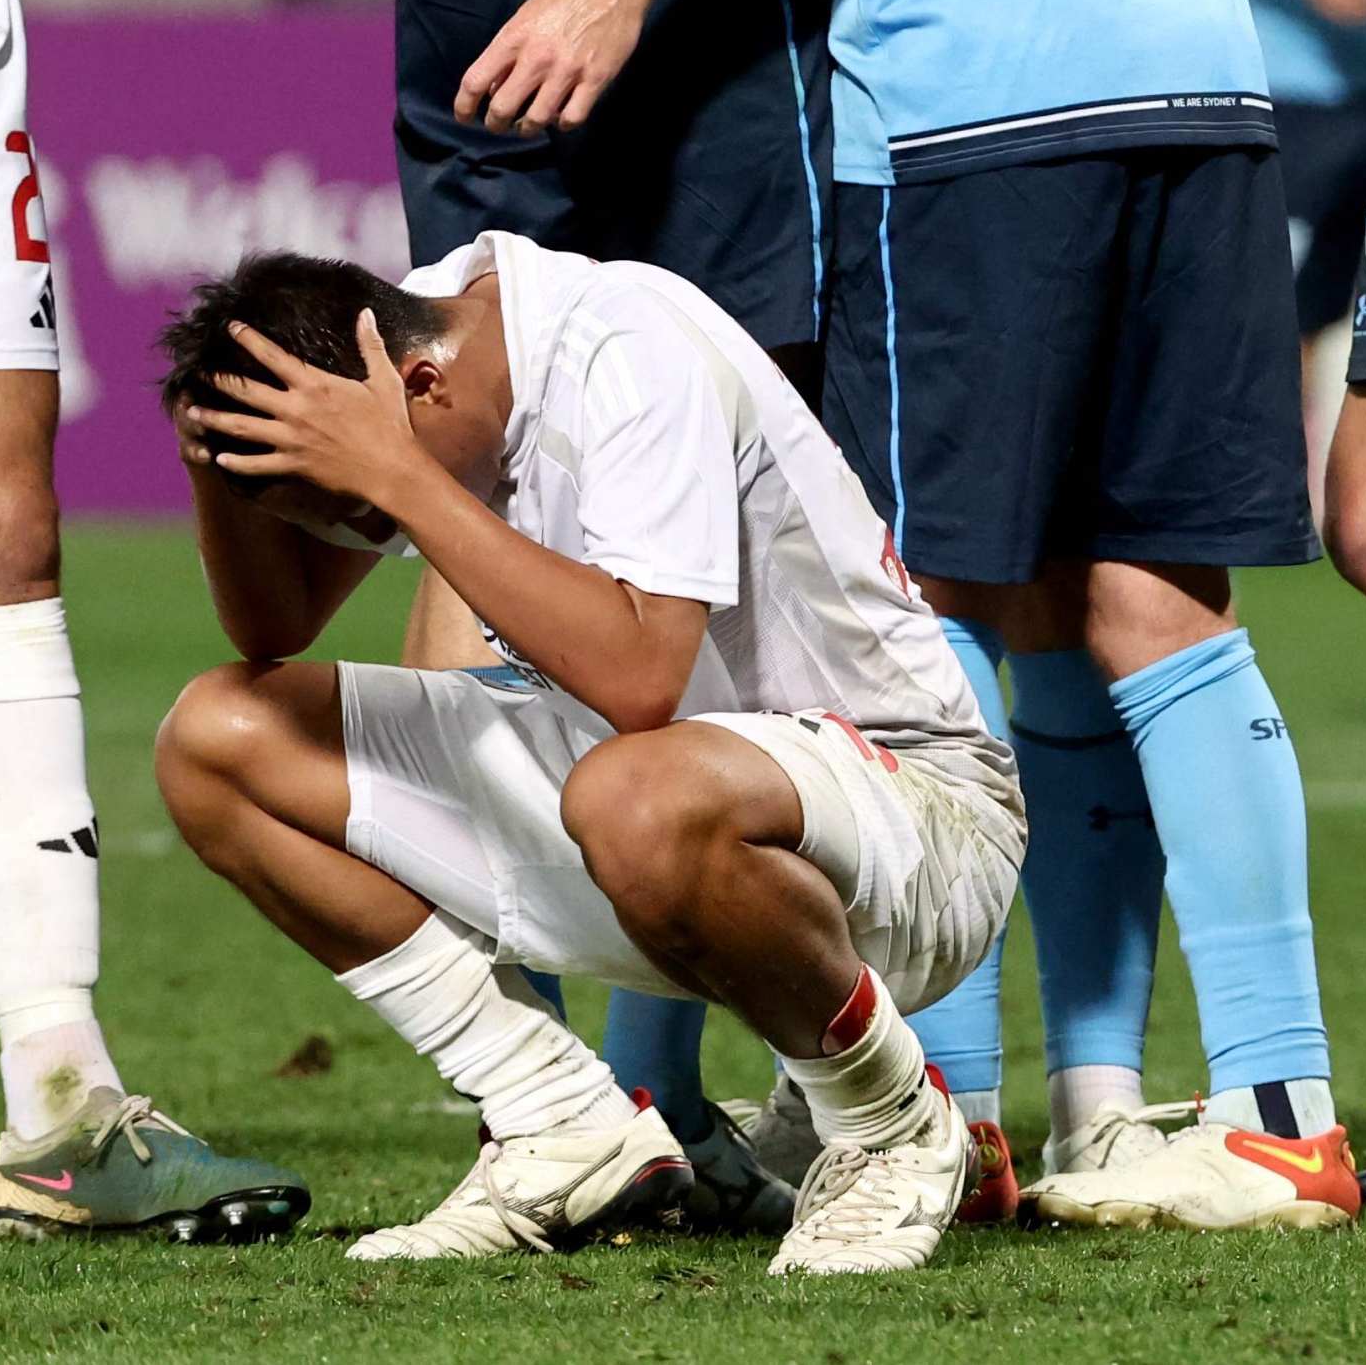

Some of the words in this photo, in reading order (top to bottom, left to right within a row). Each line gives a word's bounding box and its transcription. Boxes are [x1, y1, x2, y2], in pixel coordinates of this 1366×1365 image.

[1171, 98, 1183, 108] WE
[1186, 97, 1202, 107] ARE
[1203, 97, 1237, 107] SYDNEY
